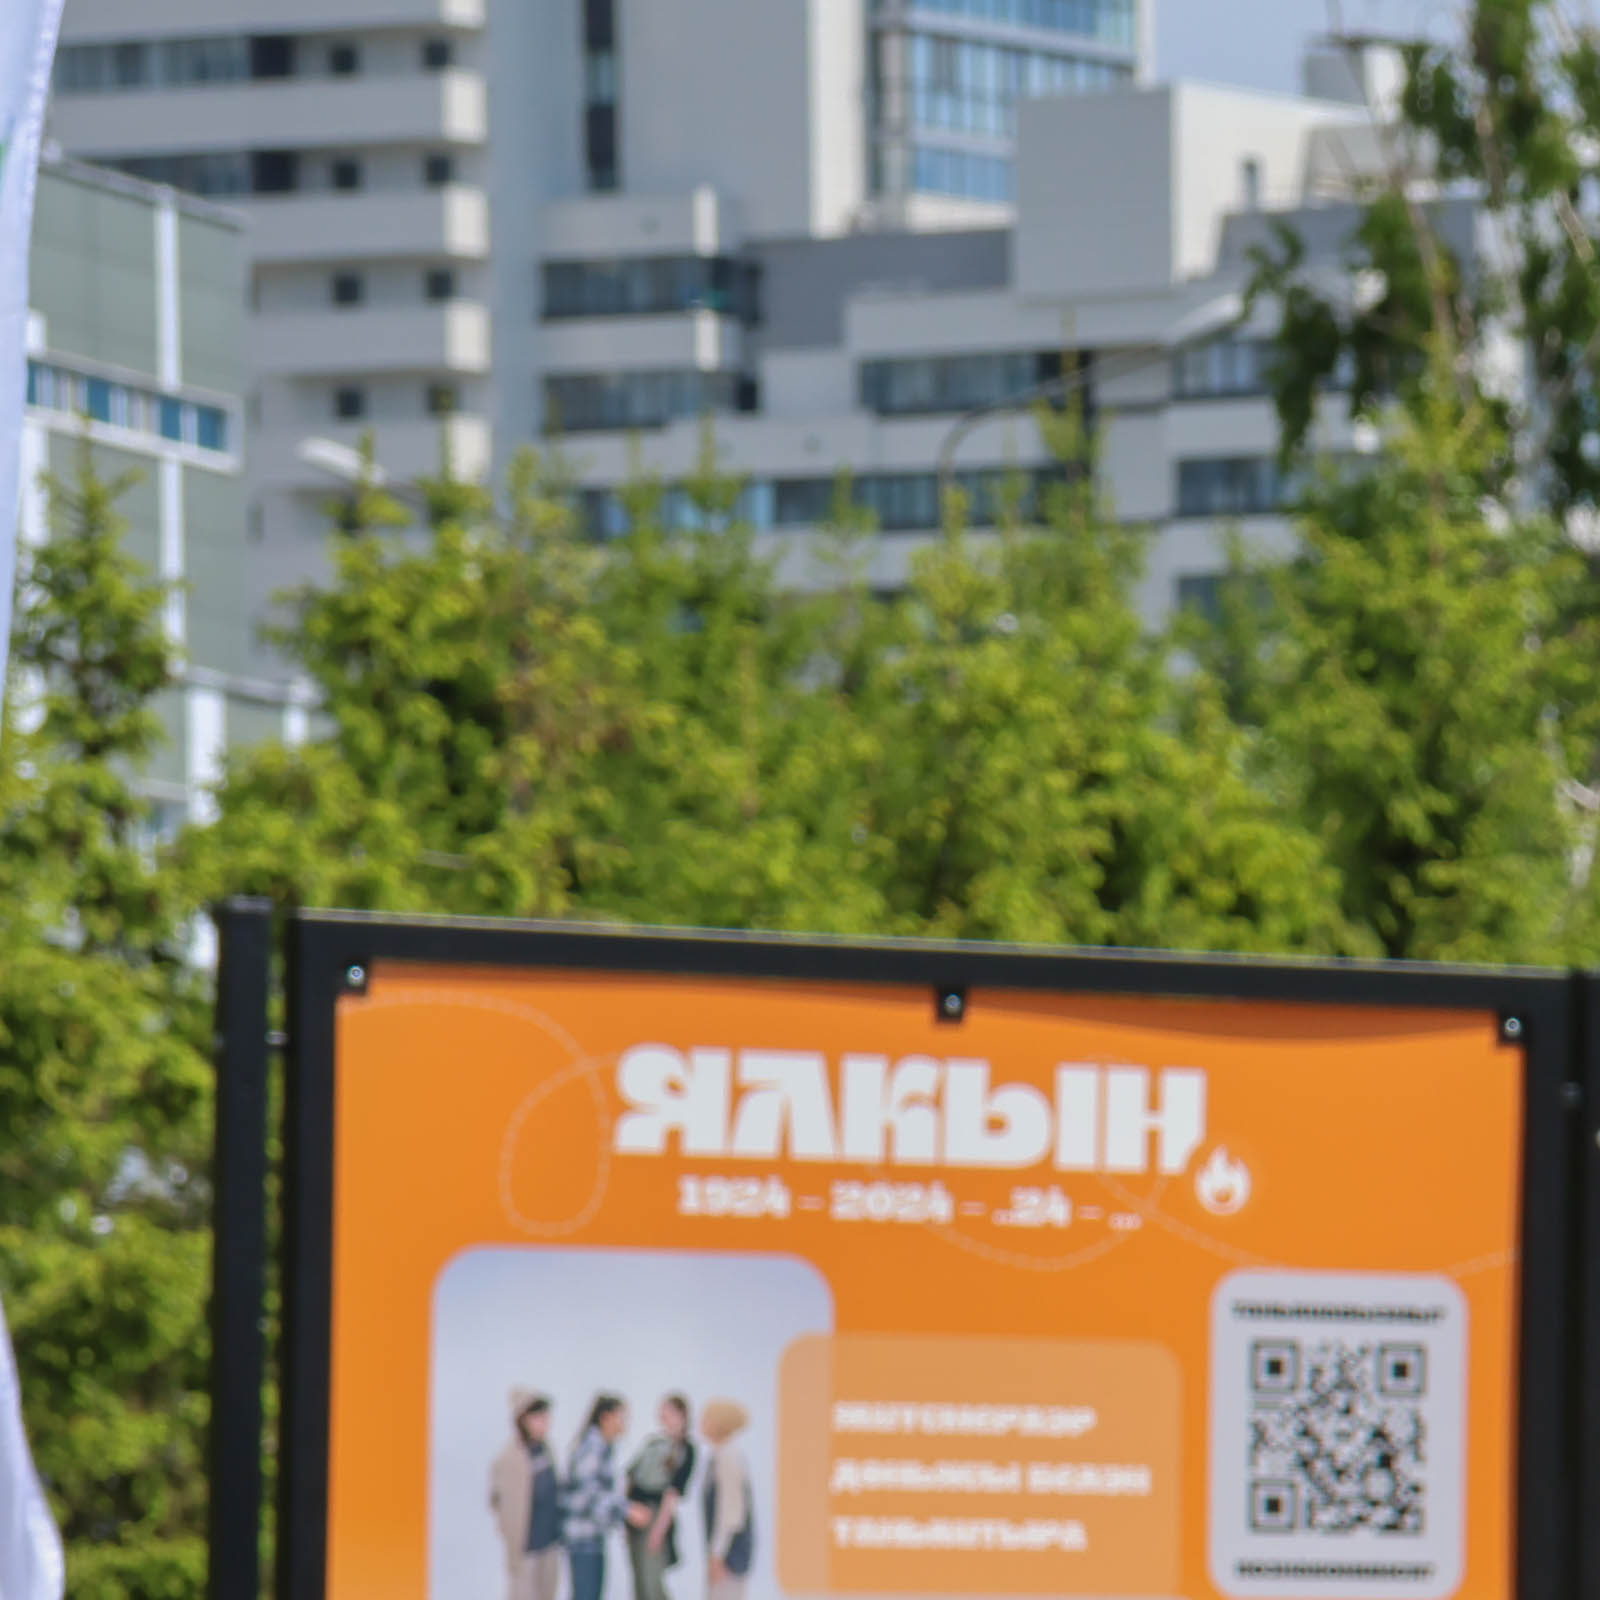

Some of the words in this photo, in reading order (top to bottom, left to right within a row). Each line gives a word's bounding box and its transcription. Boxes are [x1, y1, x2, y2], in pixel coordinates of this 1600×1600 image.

[613, 1043, 1207, 1174] ЯЛКЫН
[679, 1174, 790, 1218] 1924
[830, 1178, 953, 1224] 2024
